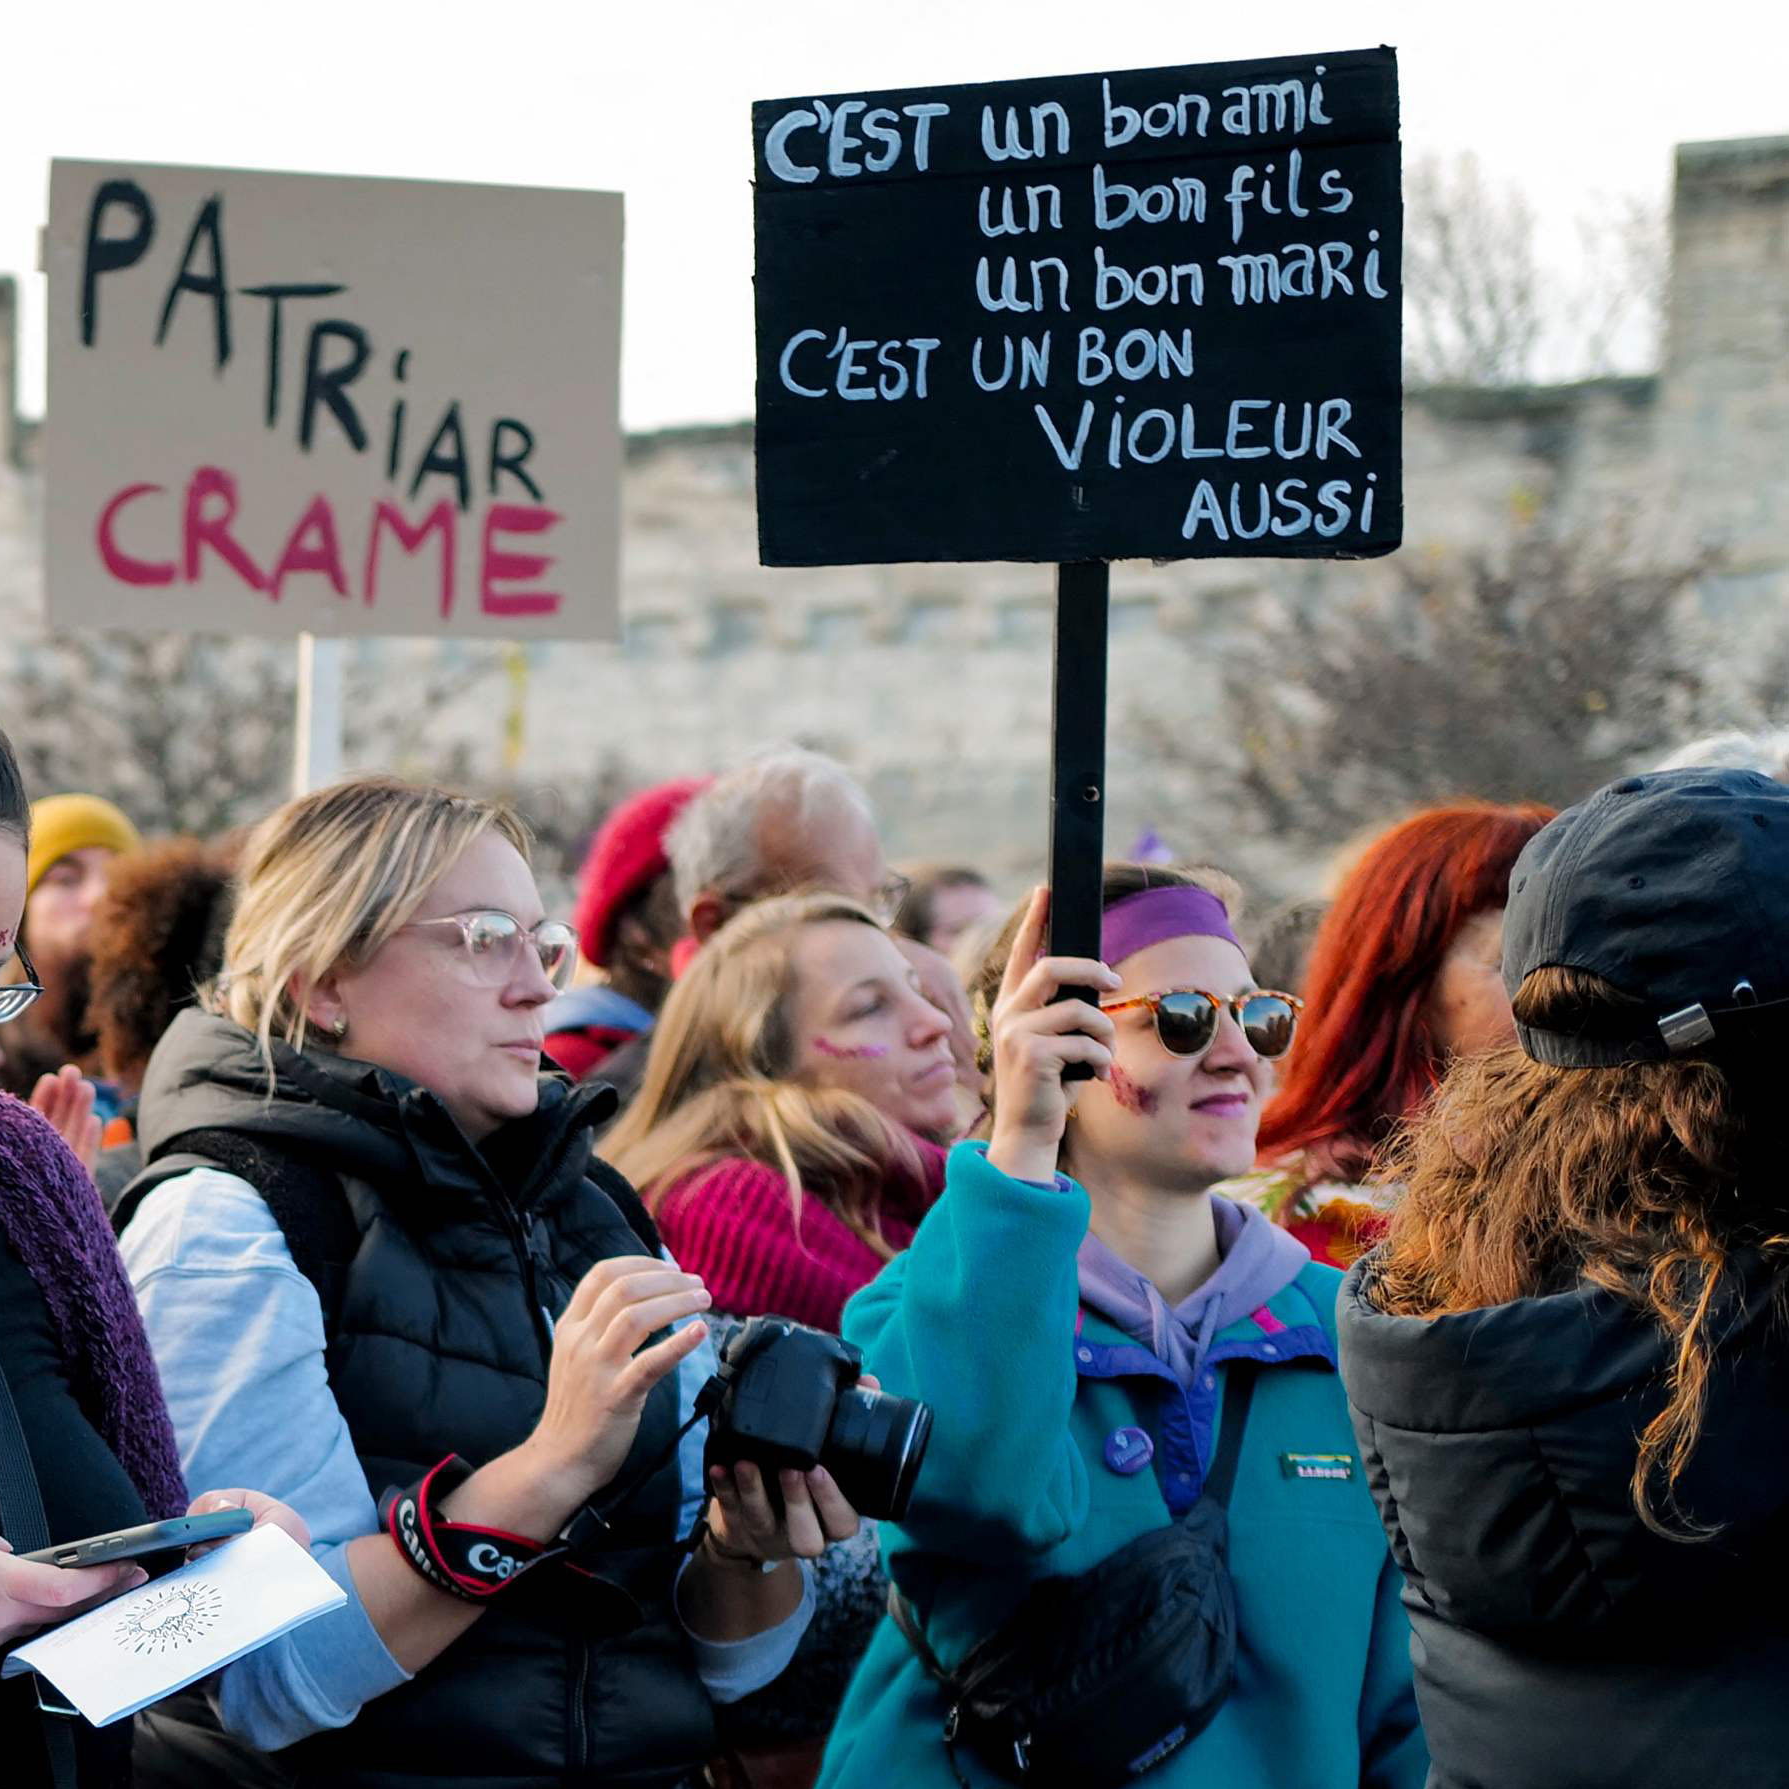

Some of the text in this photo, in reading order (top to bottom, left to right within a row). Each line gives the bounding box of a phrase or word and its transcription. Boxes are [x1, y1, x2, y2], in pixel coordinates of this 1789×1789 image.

[765, 64, 1333, 183] C'EST un bon ami
[978, 149, 1354, 245] un bon fils
[976, 256, 1070, 313] un
[1095, 246, 1203, 310] bon
[779, 326, 1193, 400] C'EST UN BON
[96, 465, 566, 620] CRAME
